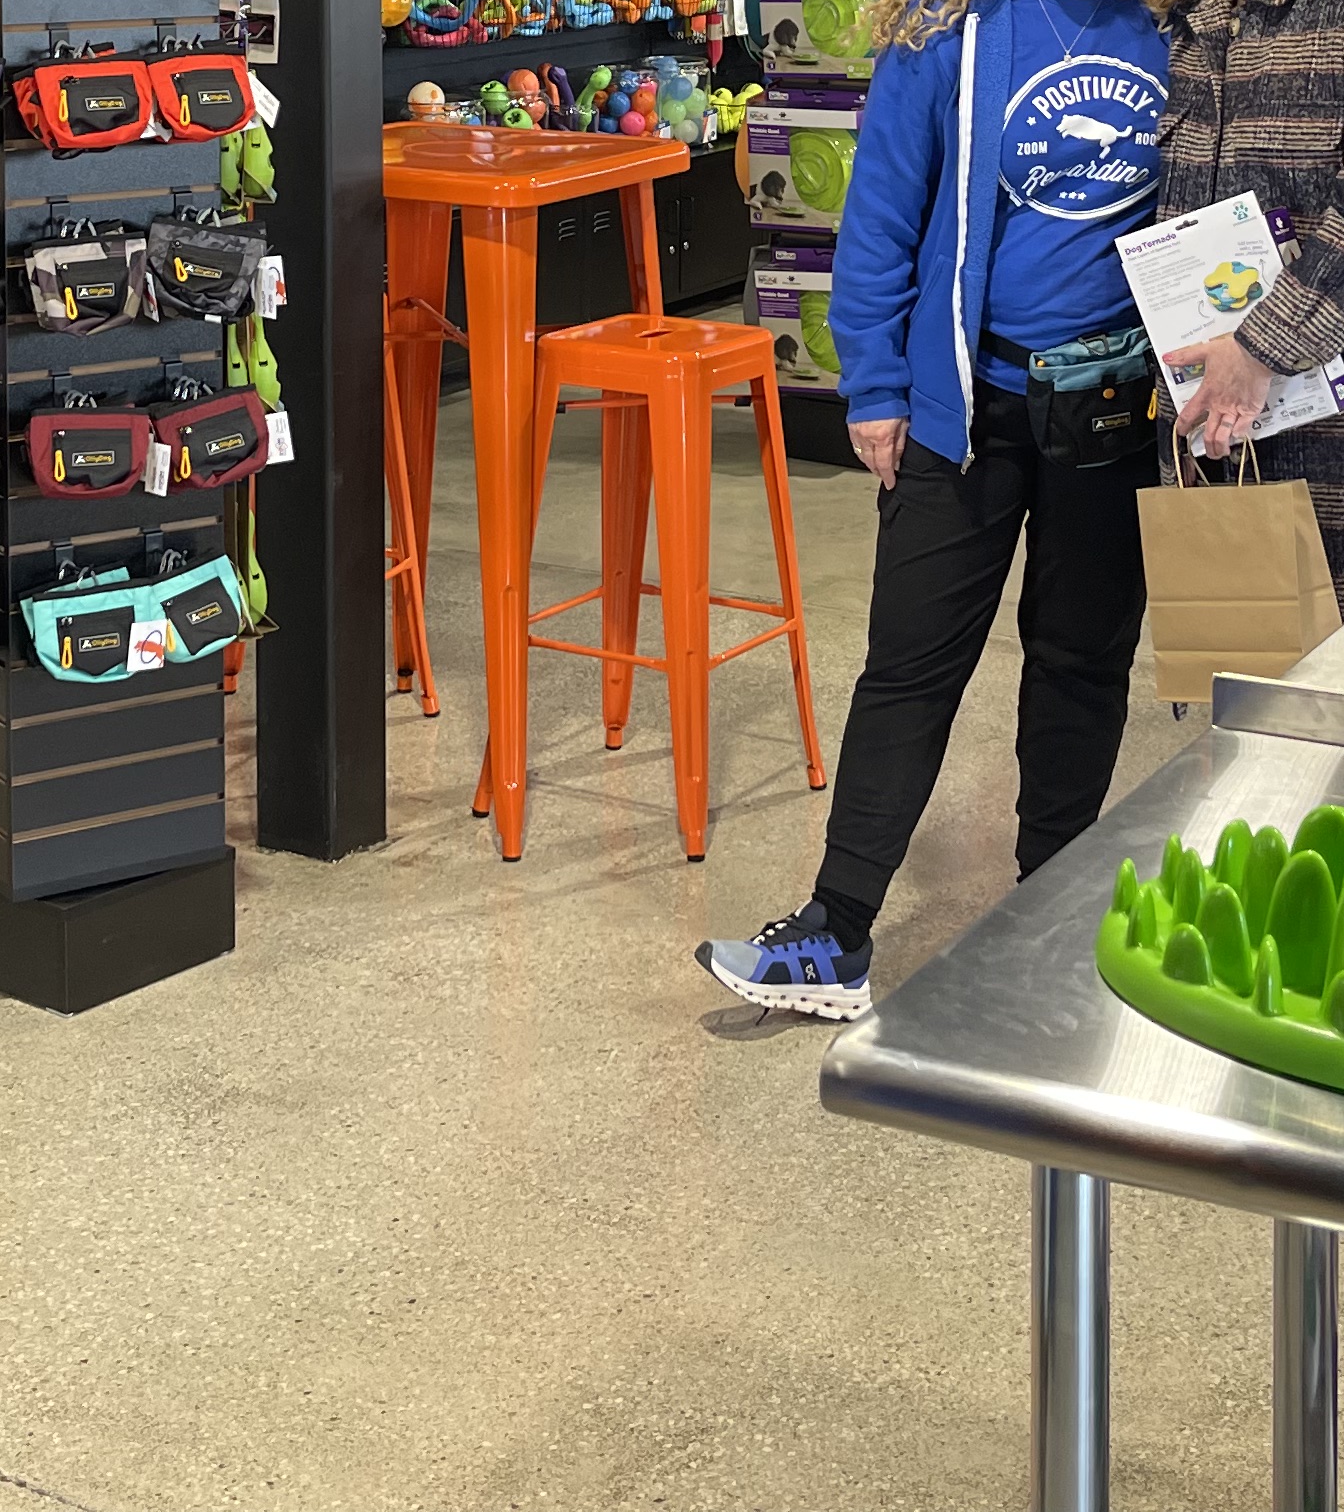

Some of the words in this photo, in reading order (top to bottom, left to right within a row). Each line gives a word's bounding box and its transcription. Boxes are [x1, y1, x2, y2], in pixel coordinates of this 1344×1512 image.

[1031, 75, 1154, 120] POSITIVELY
[1016, 140, 1048, 156] ZOOM
[1135, 132, 1157, 147] ROO
[1124, 245, 1143, 256] Dog
[1142, 233, 1177, 248] Tornado
